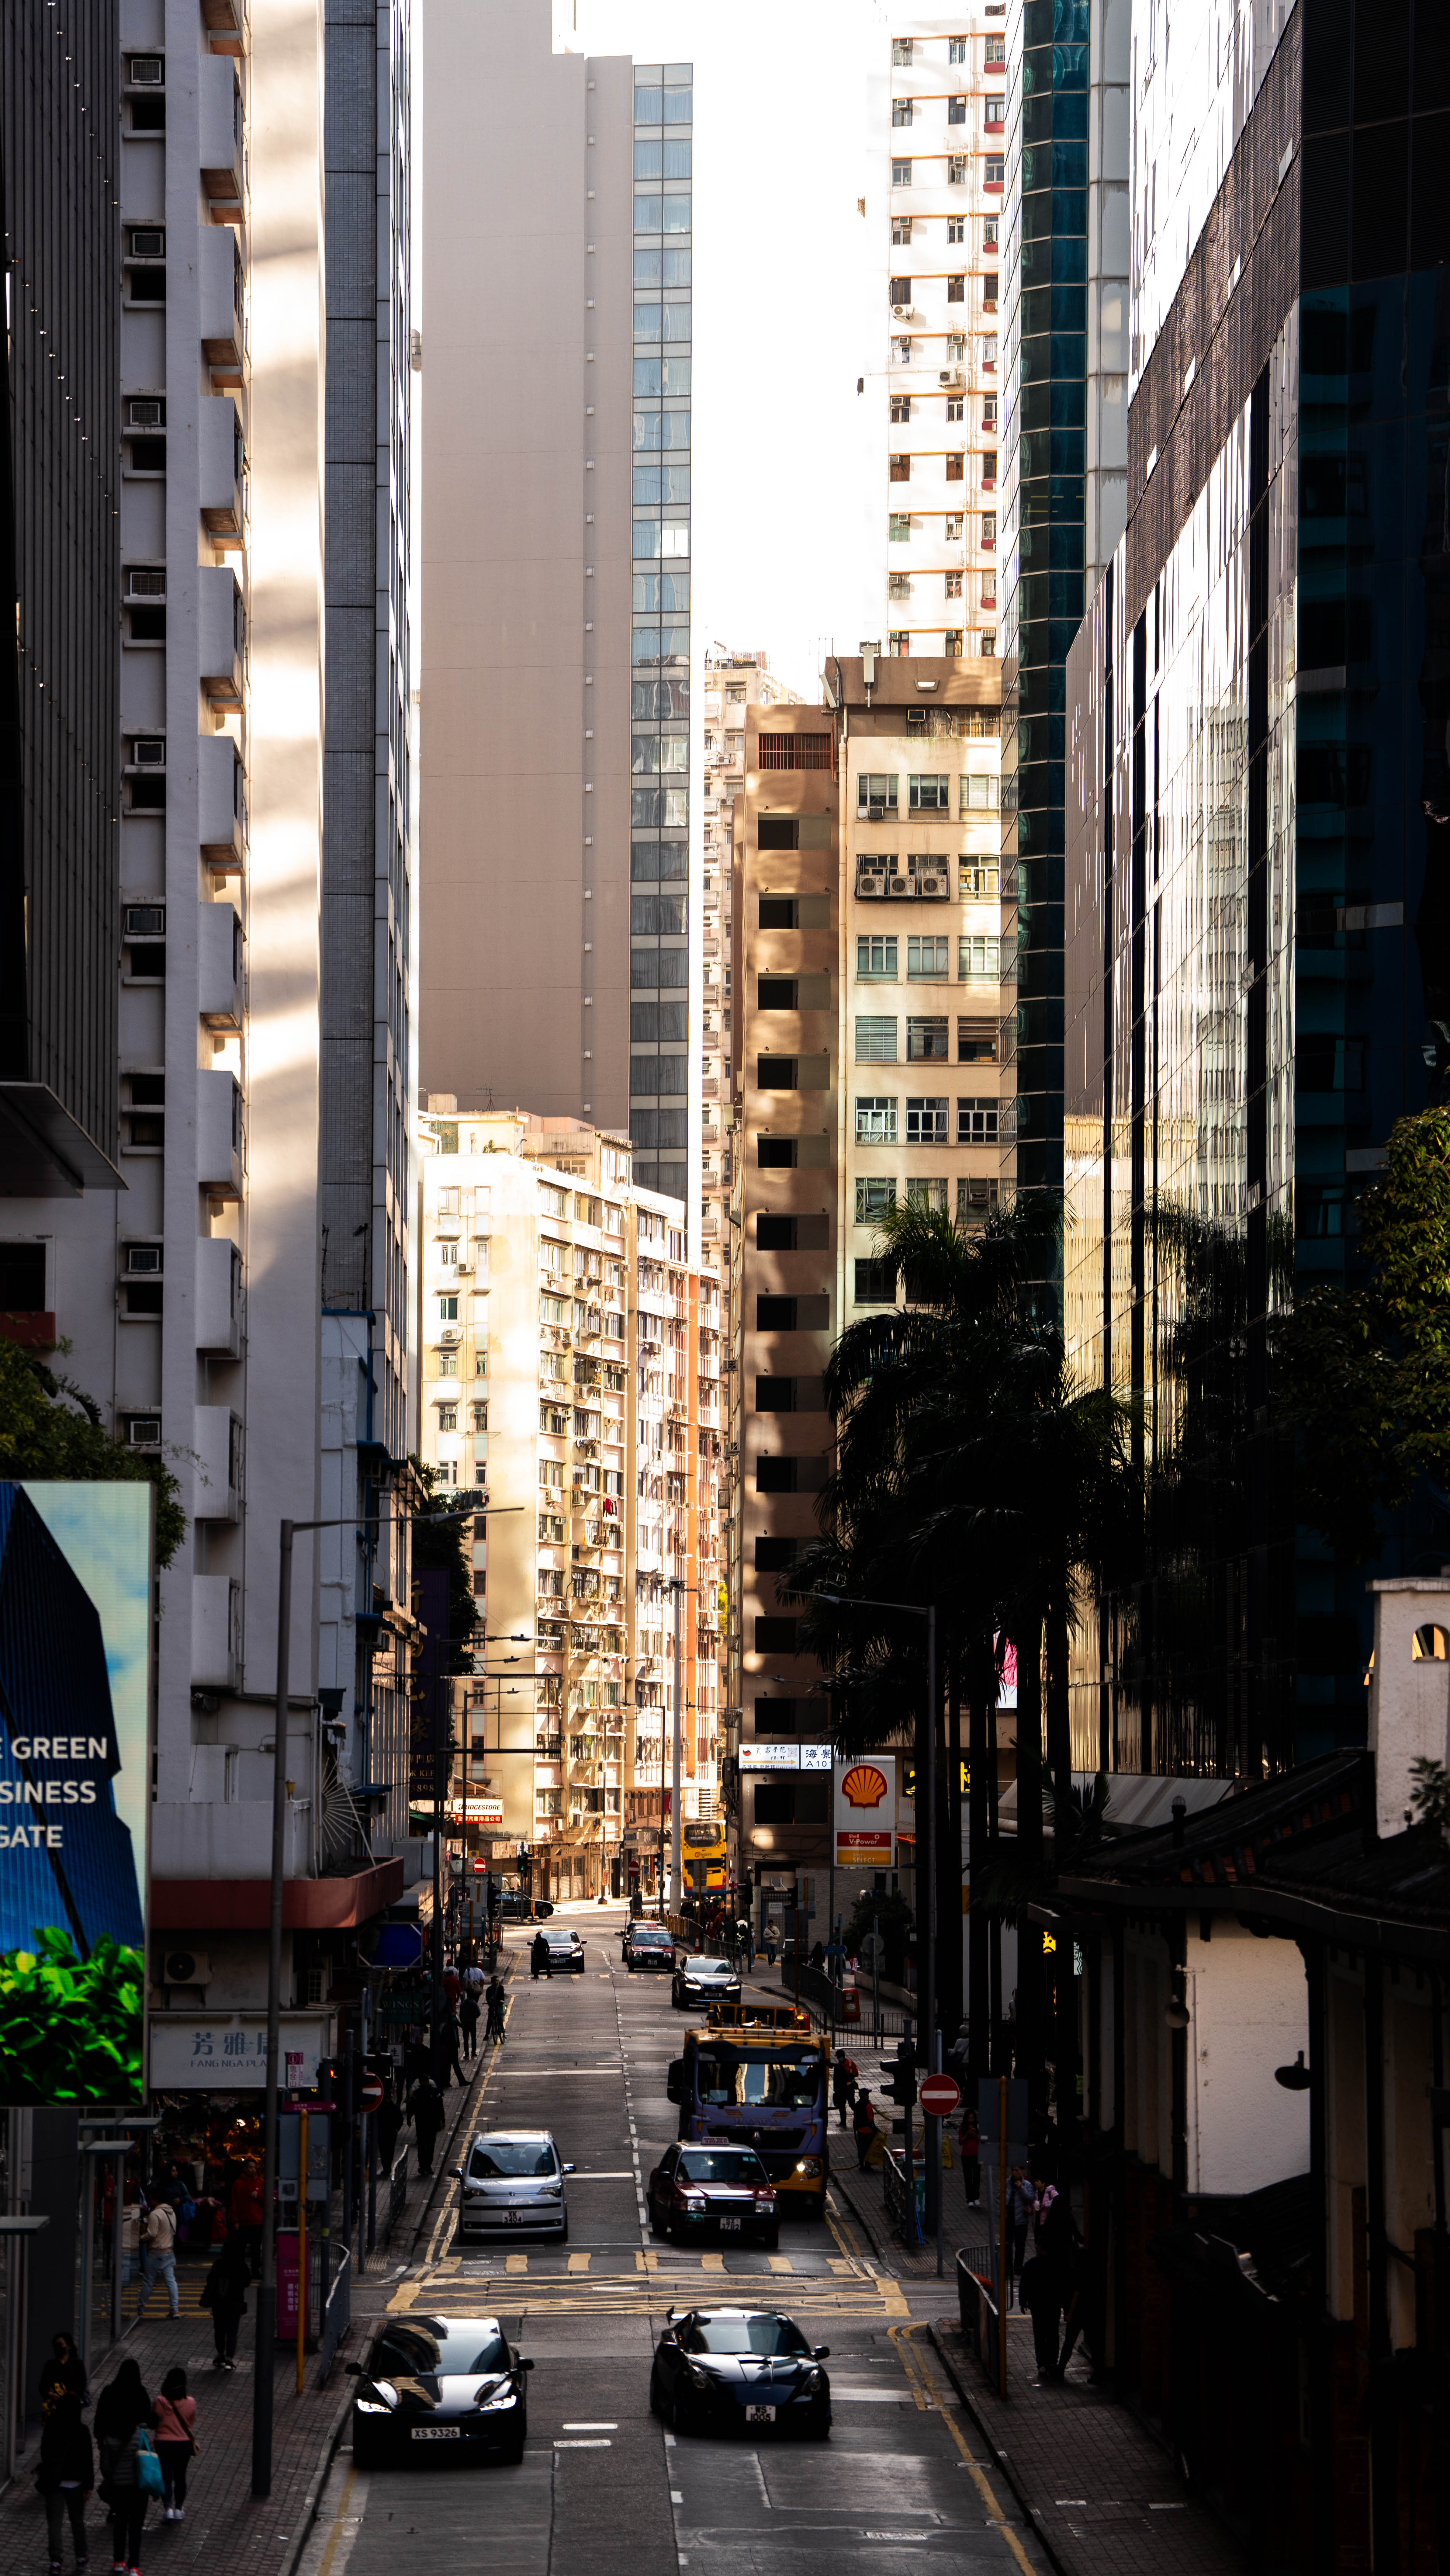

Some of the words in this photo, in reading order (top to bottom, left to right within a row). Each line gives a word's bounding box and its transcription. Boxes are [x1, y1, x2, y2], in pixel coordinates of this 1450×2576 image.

[11, 1737, 107, 1759] GREEN
[806, 1749, 831, 1759] 海景
[0, 1781, 96, 1804] SINESS
[381, 2000, 419, 2008] WINGS
[415, 2430, 428, 2438] XS
[430, 2428, 457, 2438] 9326
